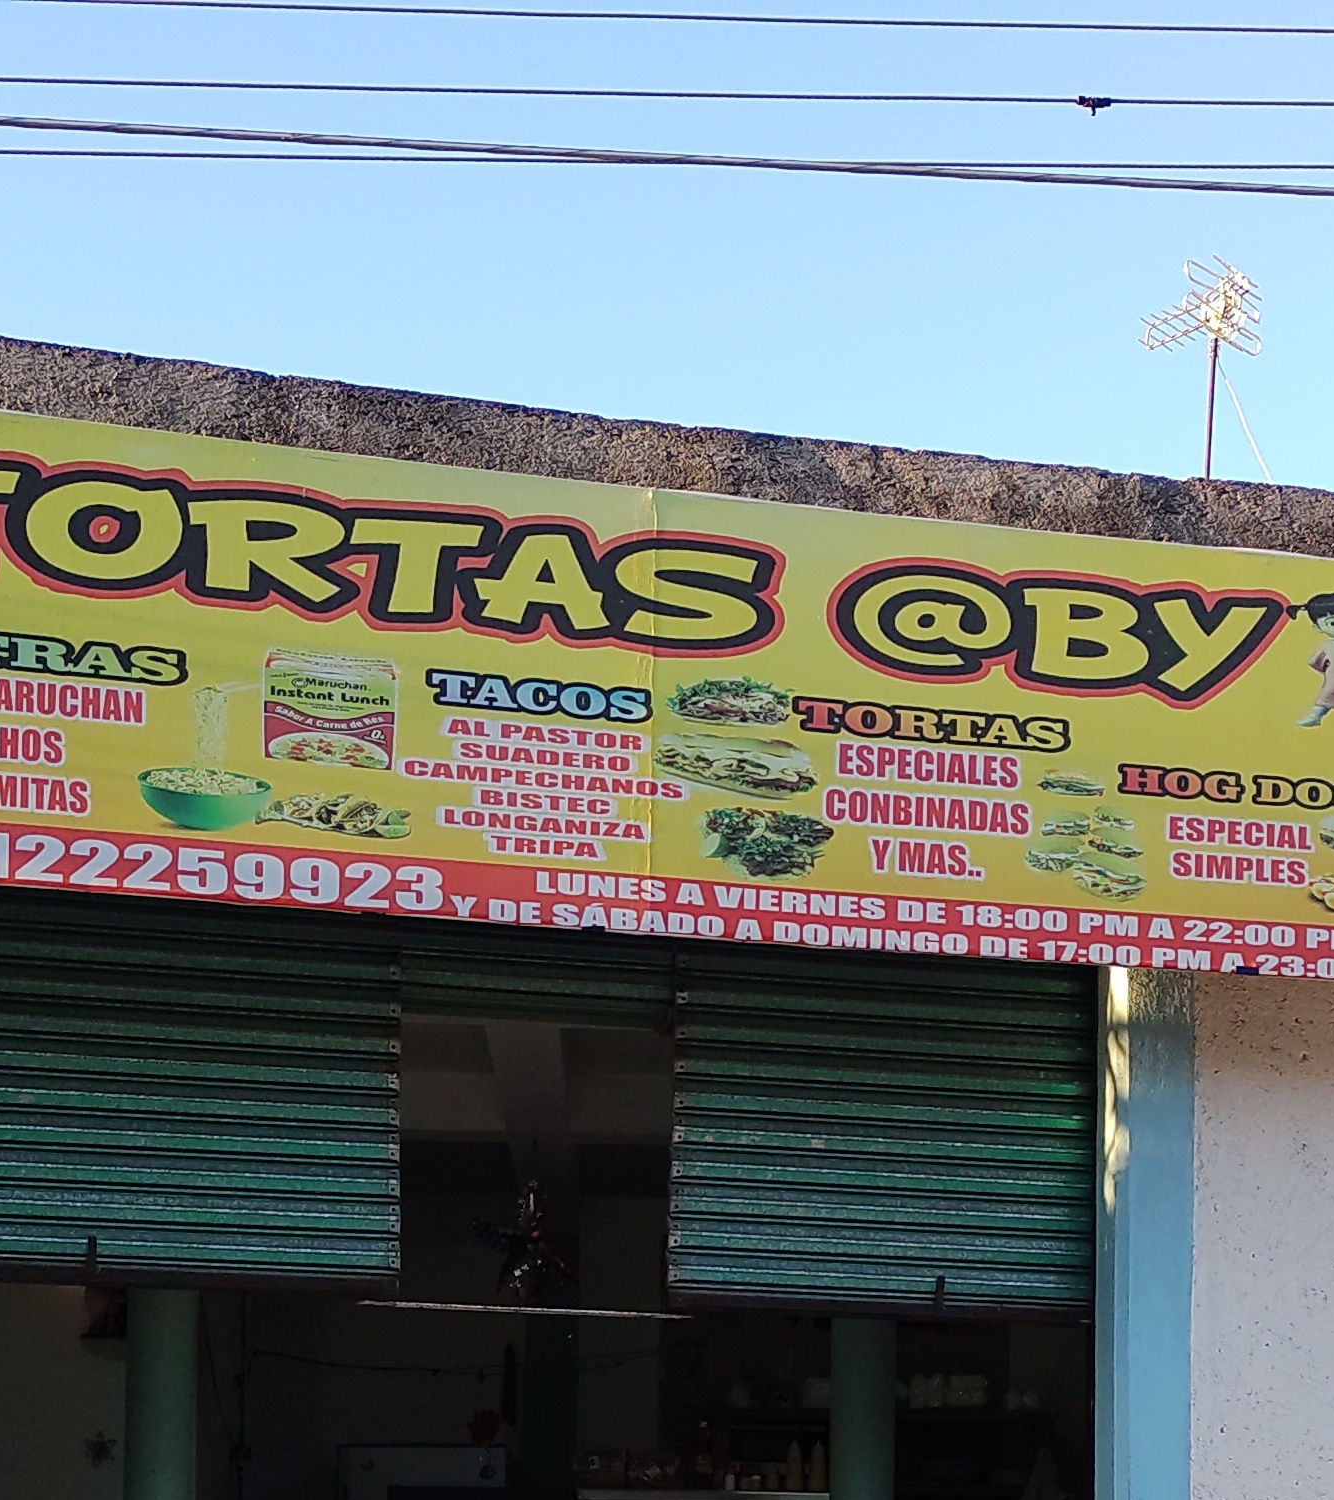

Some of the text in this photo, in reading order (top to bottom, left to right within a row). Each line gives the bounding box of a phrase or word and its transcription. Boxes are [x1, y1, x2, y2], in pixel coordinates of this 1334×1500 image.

[269, 685, 390, 706] Instant Lunch
[430, 671, 650, 720] TACOS
[446, 718, 643, 752] AL PASTOR
[798, 699, 1067, 749] TORTAS
[459, 742, 632, 772] SUADERO
[838, 742, 1019, 788] ESPECIALES
[403, 759, 684, 799] CAMPECHANOS
[1119, 766, 1243, 801] HOG
[478, 788, 612, 815] BISTEC
[824, 789, 1030, 835] CONBINADAS
[442, 807, 646, 840] LONGANIZA
[1168, 816, 1312, 851] ESPECIAL
[489, 835, 599, 858] TRIPA
[870, 838, 892, 871] Y
[1172, 853, 1306, 886] SIMPLES
[535, 870, 667, 902] LUNES
[675, 882, 705, 906] A
[713, 884, 887, 922] VIERNES
[896, 899, 947, 925] DE
[955, 903, 1068, 933] 18:00
[1078, 911, 1139, 938] PM
[1147, 917, 1175, 941] A
[1183, 919, 1296, 949] 22:00
[450, 894, 478, 918] Y
[487, 898, 542, 925] DE
[551, 901, 725, 937] SÁBADO
[733, 918, 763, 942] A
[772, 921, 969, 956] DOMINGO
[978, 935, 1029, 961] DE
[1037, 940, 1142, 968] 17:00
[1151, 946, 1211, 972] PM
[1219, 952, 1248, 974] A
